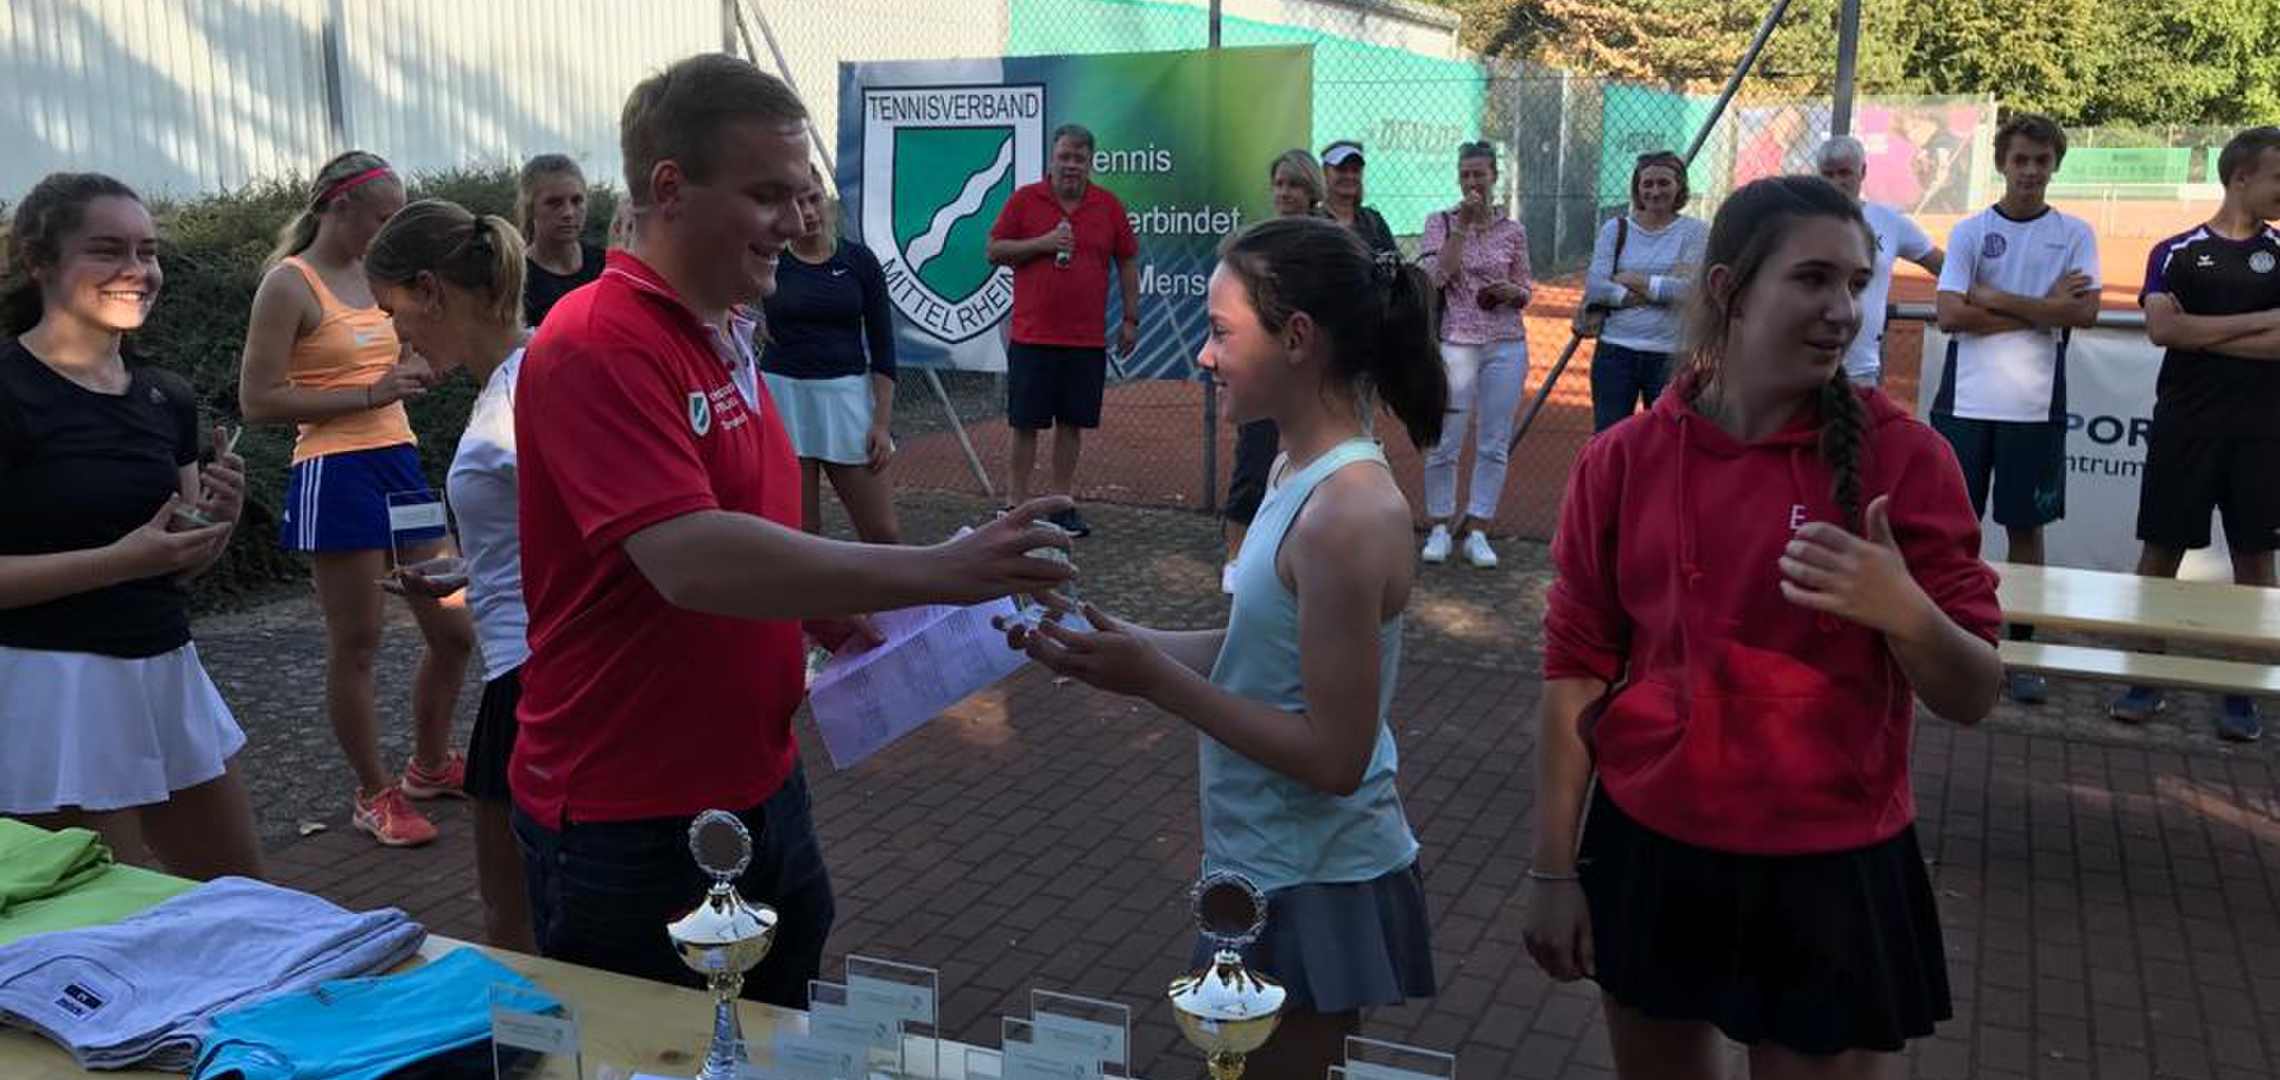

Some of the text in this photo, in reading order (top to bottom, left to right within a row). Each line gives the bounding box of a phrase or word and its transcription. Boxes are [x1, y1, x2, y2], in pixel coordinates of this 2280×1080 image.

[868, 94, 1040, 121] TENNISVERBAND
[1092, 142, 1172, 173] ennis
[1126, 205, 1241, 235] erbindet
[1138, 264, 1207, 296] Mens
[2066, 414, 2153, 447] POR
[2066, 455, 2145, 477] ntrum
